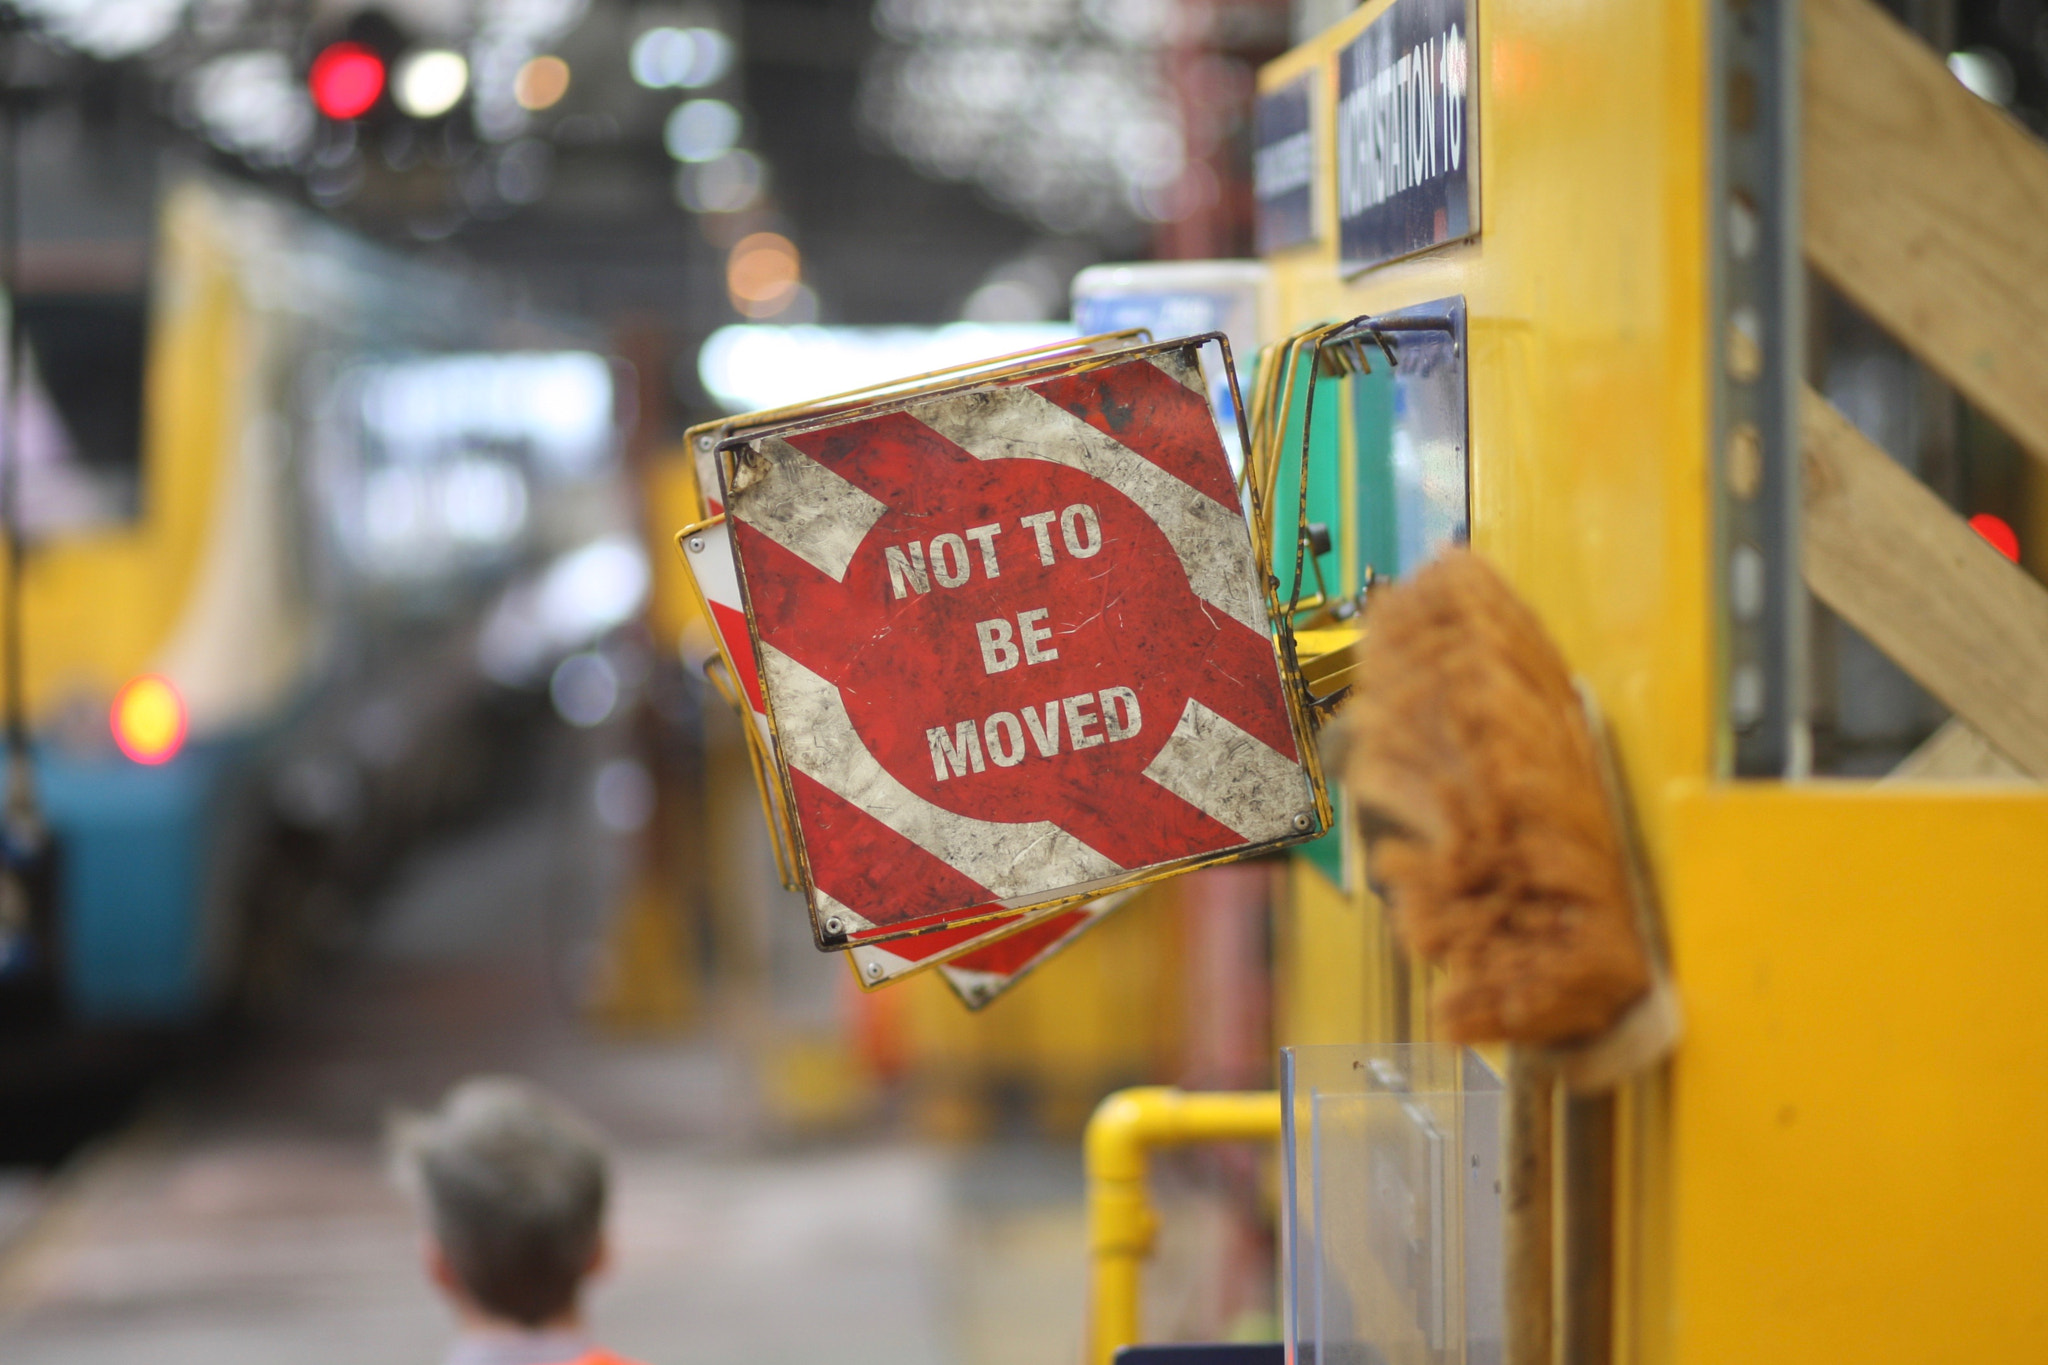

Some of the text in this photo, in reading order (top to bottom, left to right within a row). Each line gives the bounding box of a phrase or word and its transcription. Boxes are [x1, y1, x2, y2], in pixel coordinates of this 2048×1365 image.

[884, 503, 1102, 600] NOT TO
[975, 607, 1059, 675] BE
[926, 685, 1142, 781] MOVED
